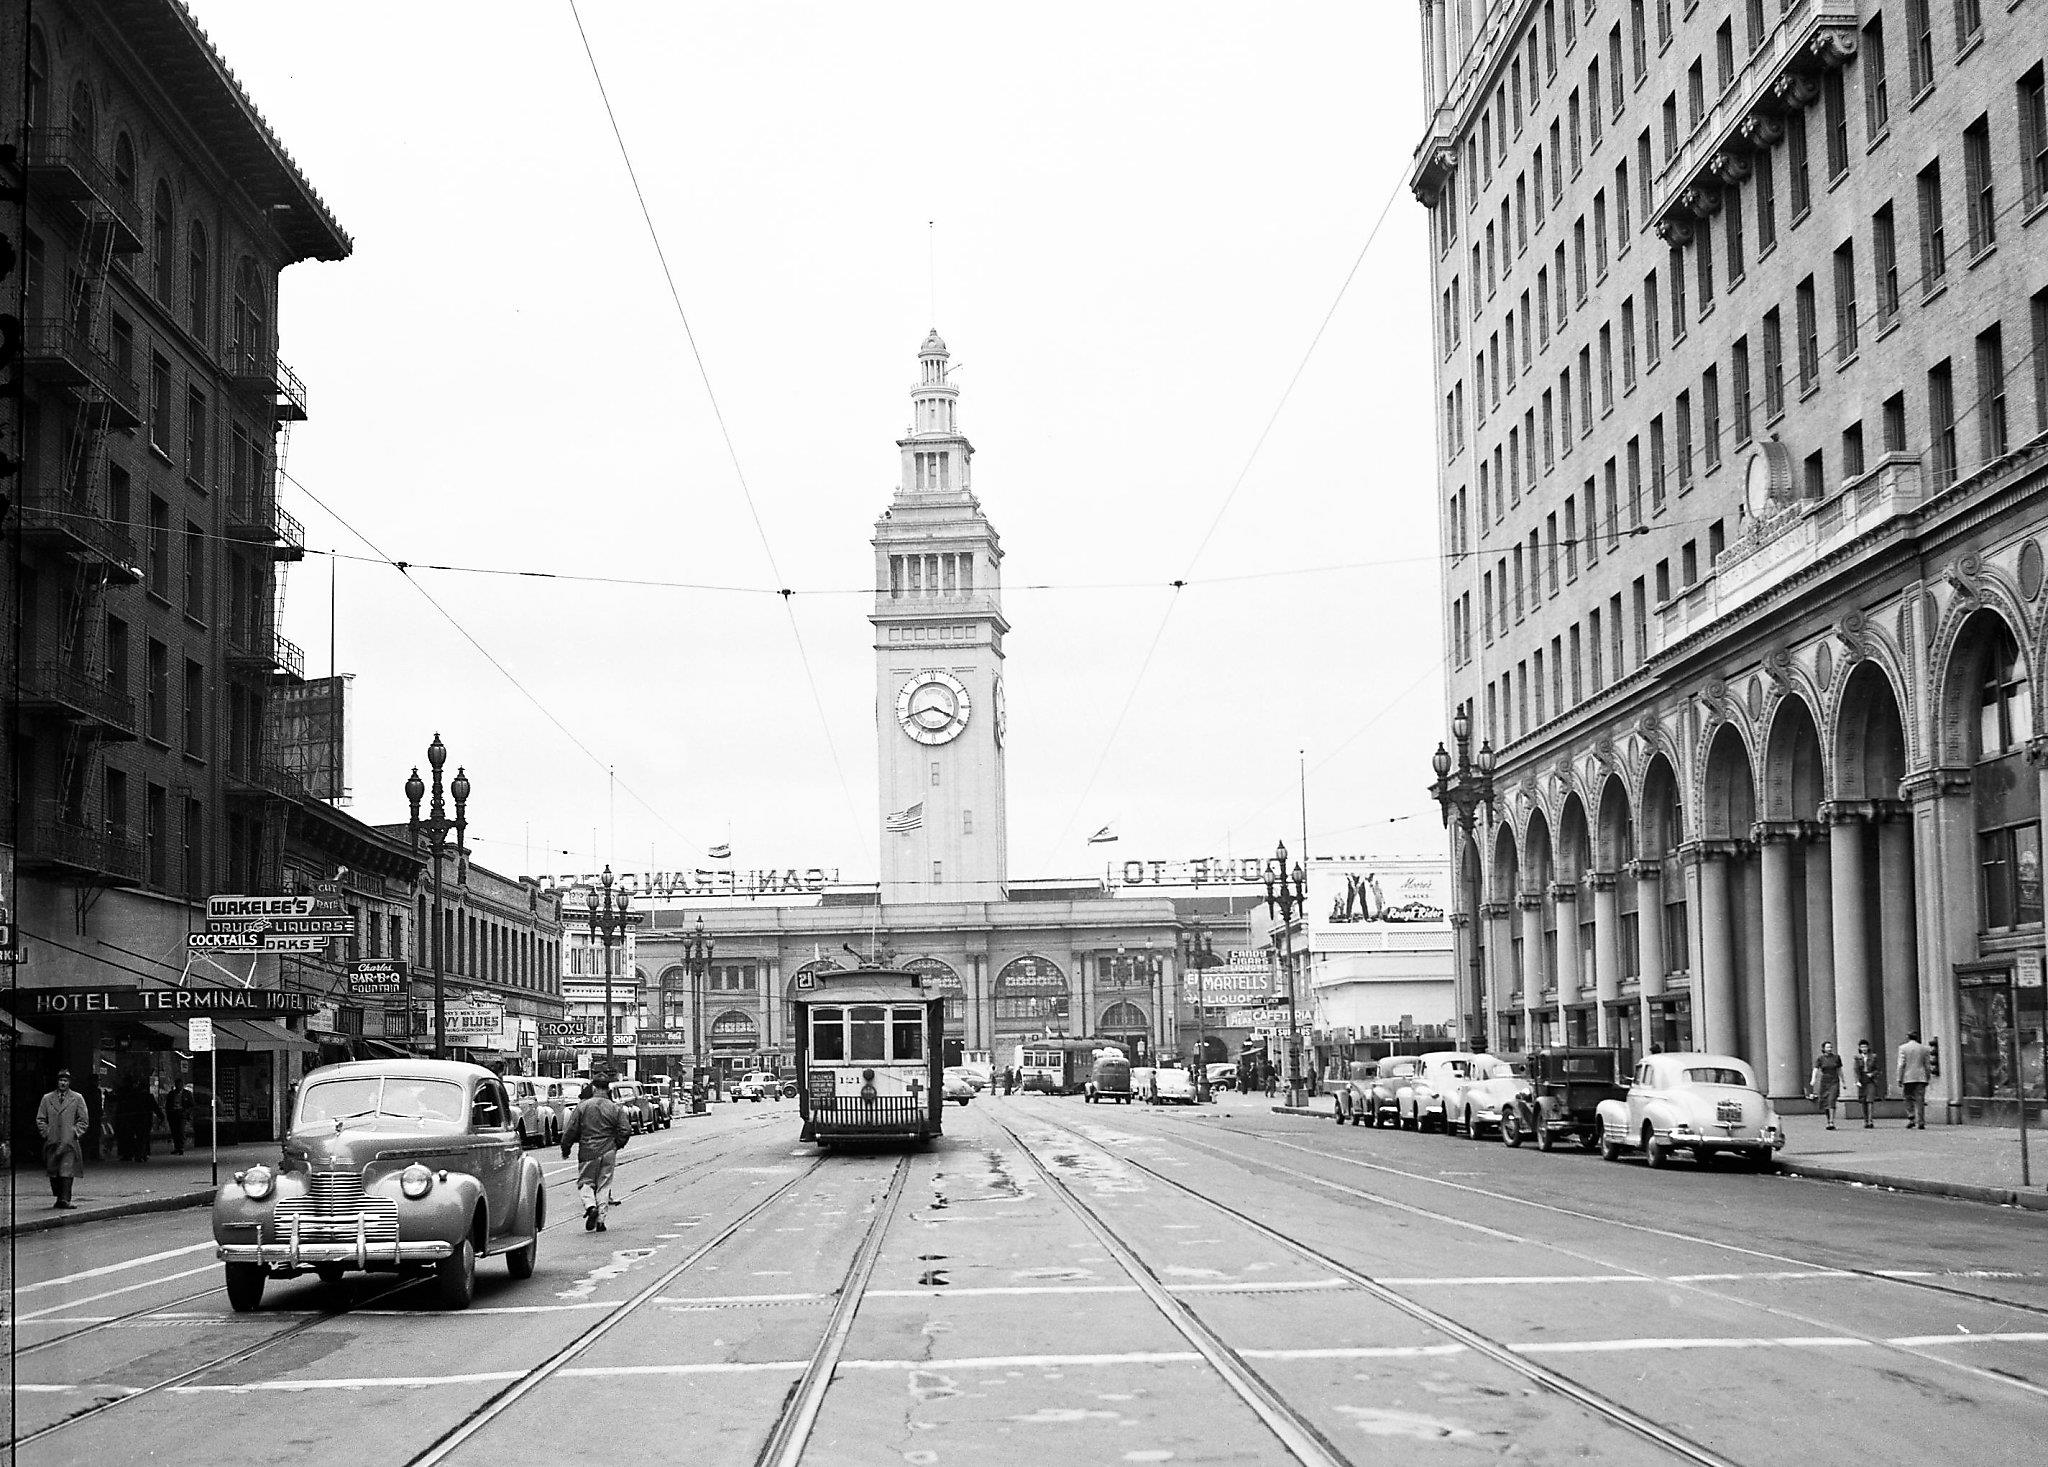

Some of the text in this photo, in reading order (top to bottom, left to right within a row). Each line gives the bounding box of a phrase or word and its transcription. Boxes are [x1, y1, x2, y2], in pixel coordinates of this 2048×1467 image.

[318, 884, 337, 893] CUT
[210, 897, 309, 916] WAKELEE'S
[275, 921, 344, 933] LIQUORS
[189, 934, 258, 946] COCKTAILS
[1231, 950, 1267, 958] CANDY
[1229, 957, 1269, 965] CIGARS
[352, 984, 400, 993] FOUNTAIN
[1203, 975, 1268, 990] MARTELLS
[37, 990, 258, 1011] HOTEL TERMINAL
[266, 992, 303, 1009] HOTEL
[462, 1016, 499, 1027] BLUES
[549, 1023, 584, 1035] ROXY
[613, 1035, 634, 1044] SHOP
